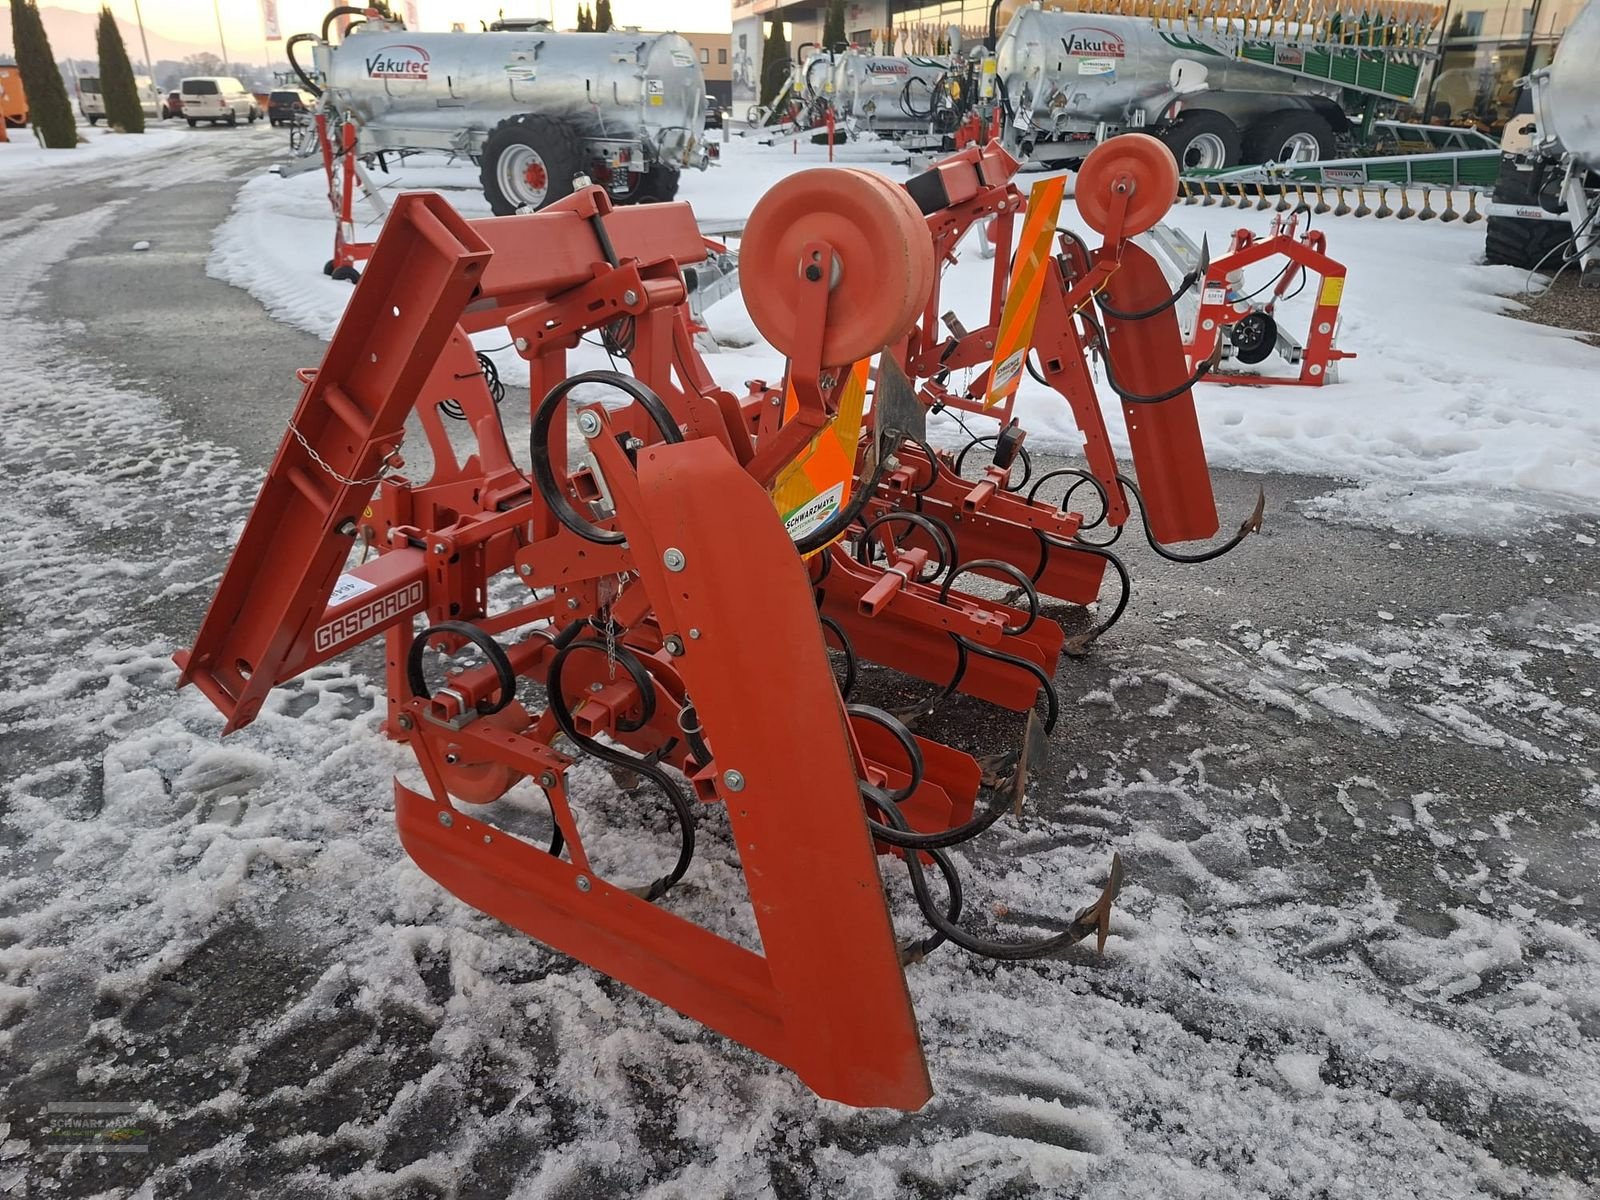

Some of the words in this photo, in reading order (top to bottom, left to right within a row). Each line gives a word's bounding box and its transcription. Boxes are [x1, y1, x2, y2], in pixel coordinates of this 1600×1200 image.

[1061, 34, 1125, 55] Vakutec
[366, 53, 429, 77] Vakutec
[786, 495, 835, 529] SCHWARZMAYR
[317, 584, 421, 649] GASPARDO
